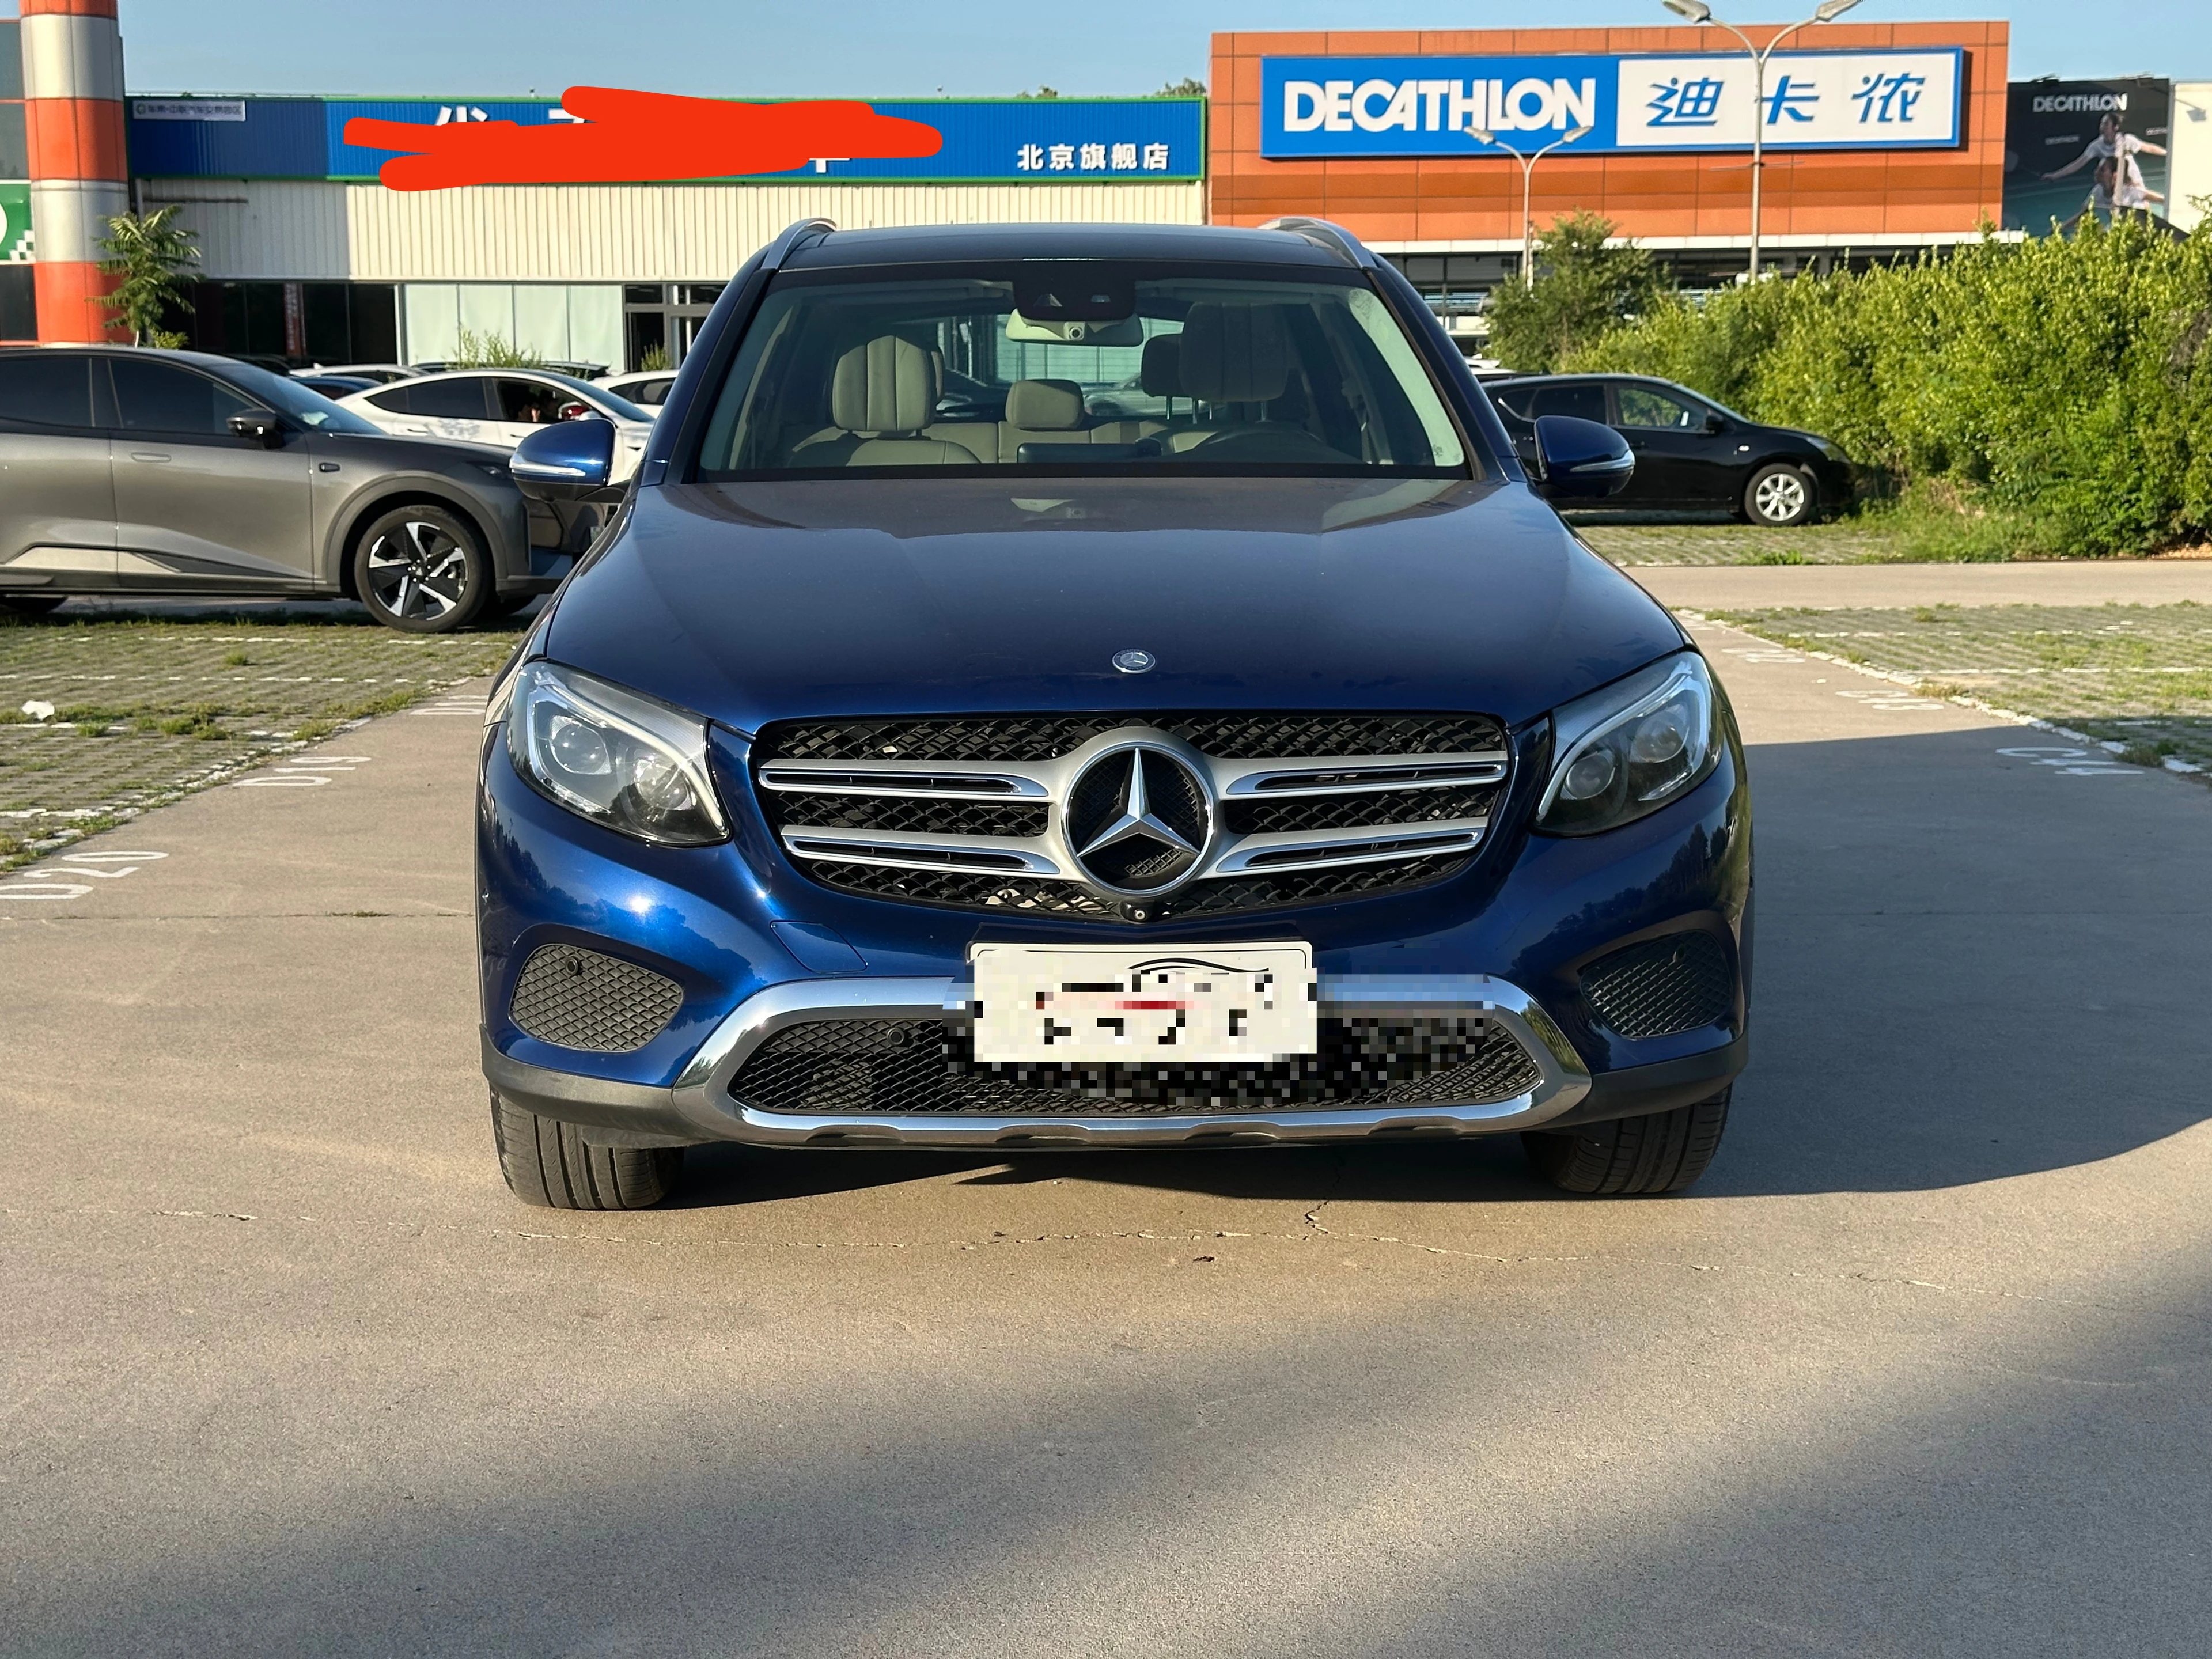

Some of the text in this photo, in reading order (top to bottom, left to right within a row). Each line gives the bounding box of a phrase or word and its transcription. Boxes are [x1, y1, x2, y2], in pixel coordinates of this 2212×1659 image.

[1284, 78, 1596, 132] DECATHLON
[1647, 73, 1925, 126] 迪卡侬
[2032, 93, 2128, 112] DECATHLON
[1017, 143, 1168, 170] 北京旗舰店
[232, 756, 372, 786] D19
[0, 851, 169, 899] D20
